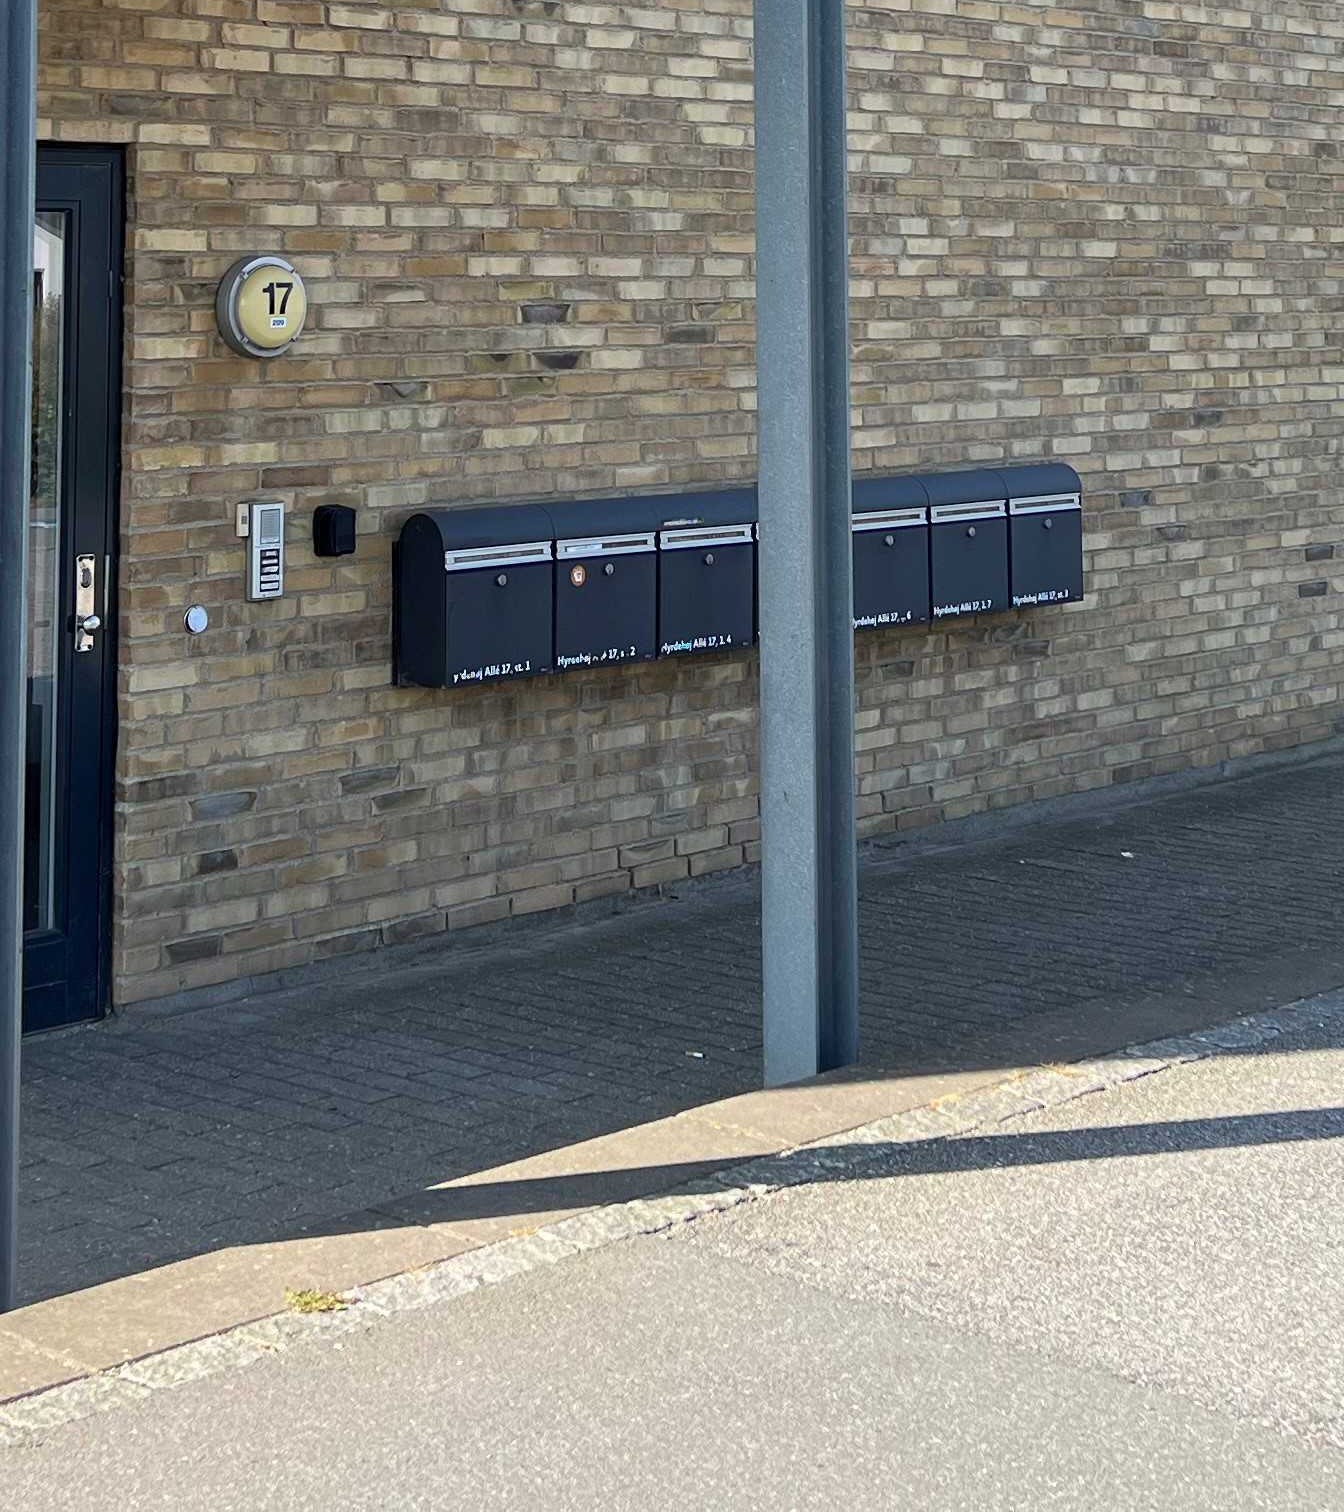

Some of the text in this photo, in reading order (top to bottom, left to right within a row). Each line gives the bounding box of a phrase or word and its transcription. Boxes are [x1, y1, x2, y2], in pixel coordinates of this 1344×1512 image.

[262, 282, 293, 315] 17
[630, 646, 636, 656] 2
[525, 660, 531, 671] 1
